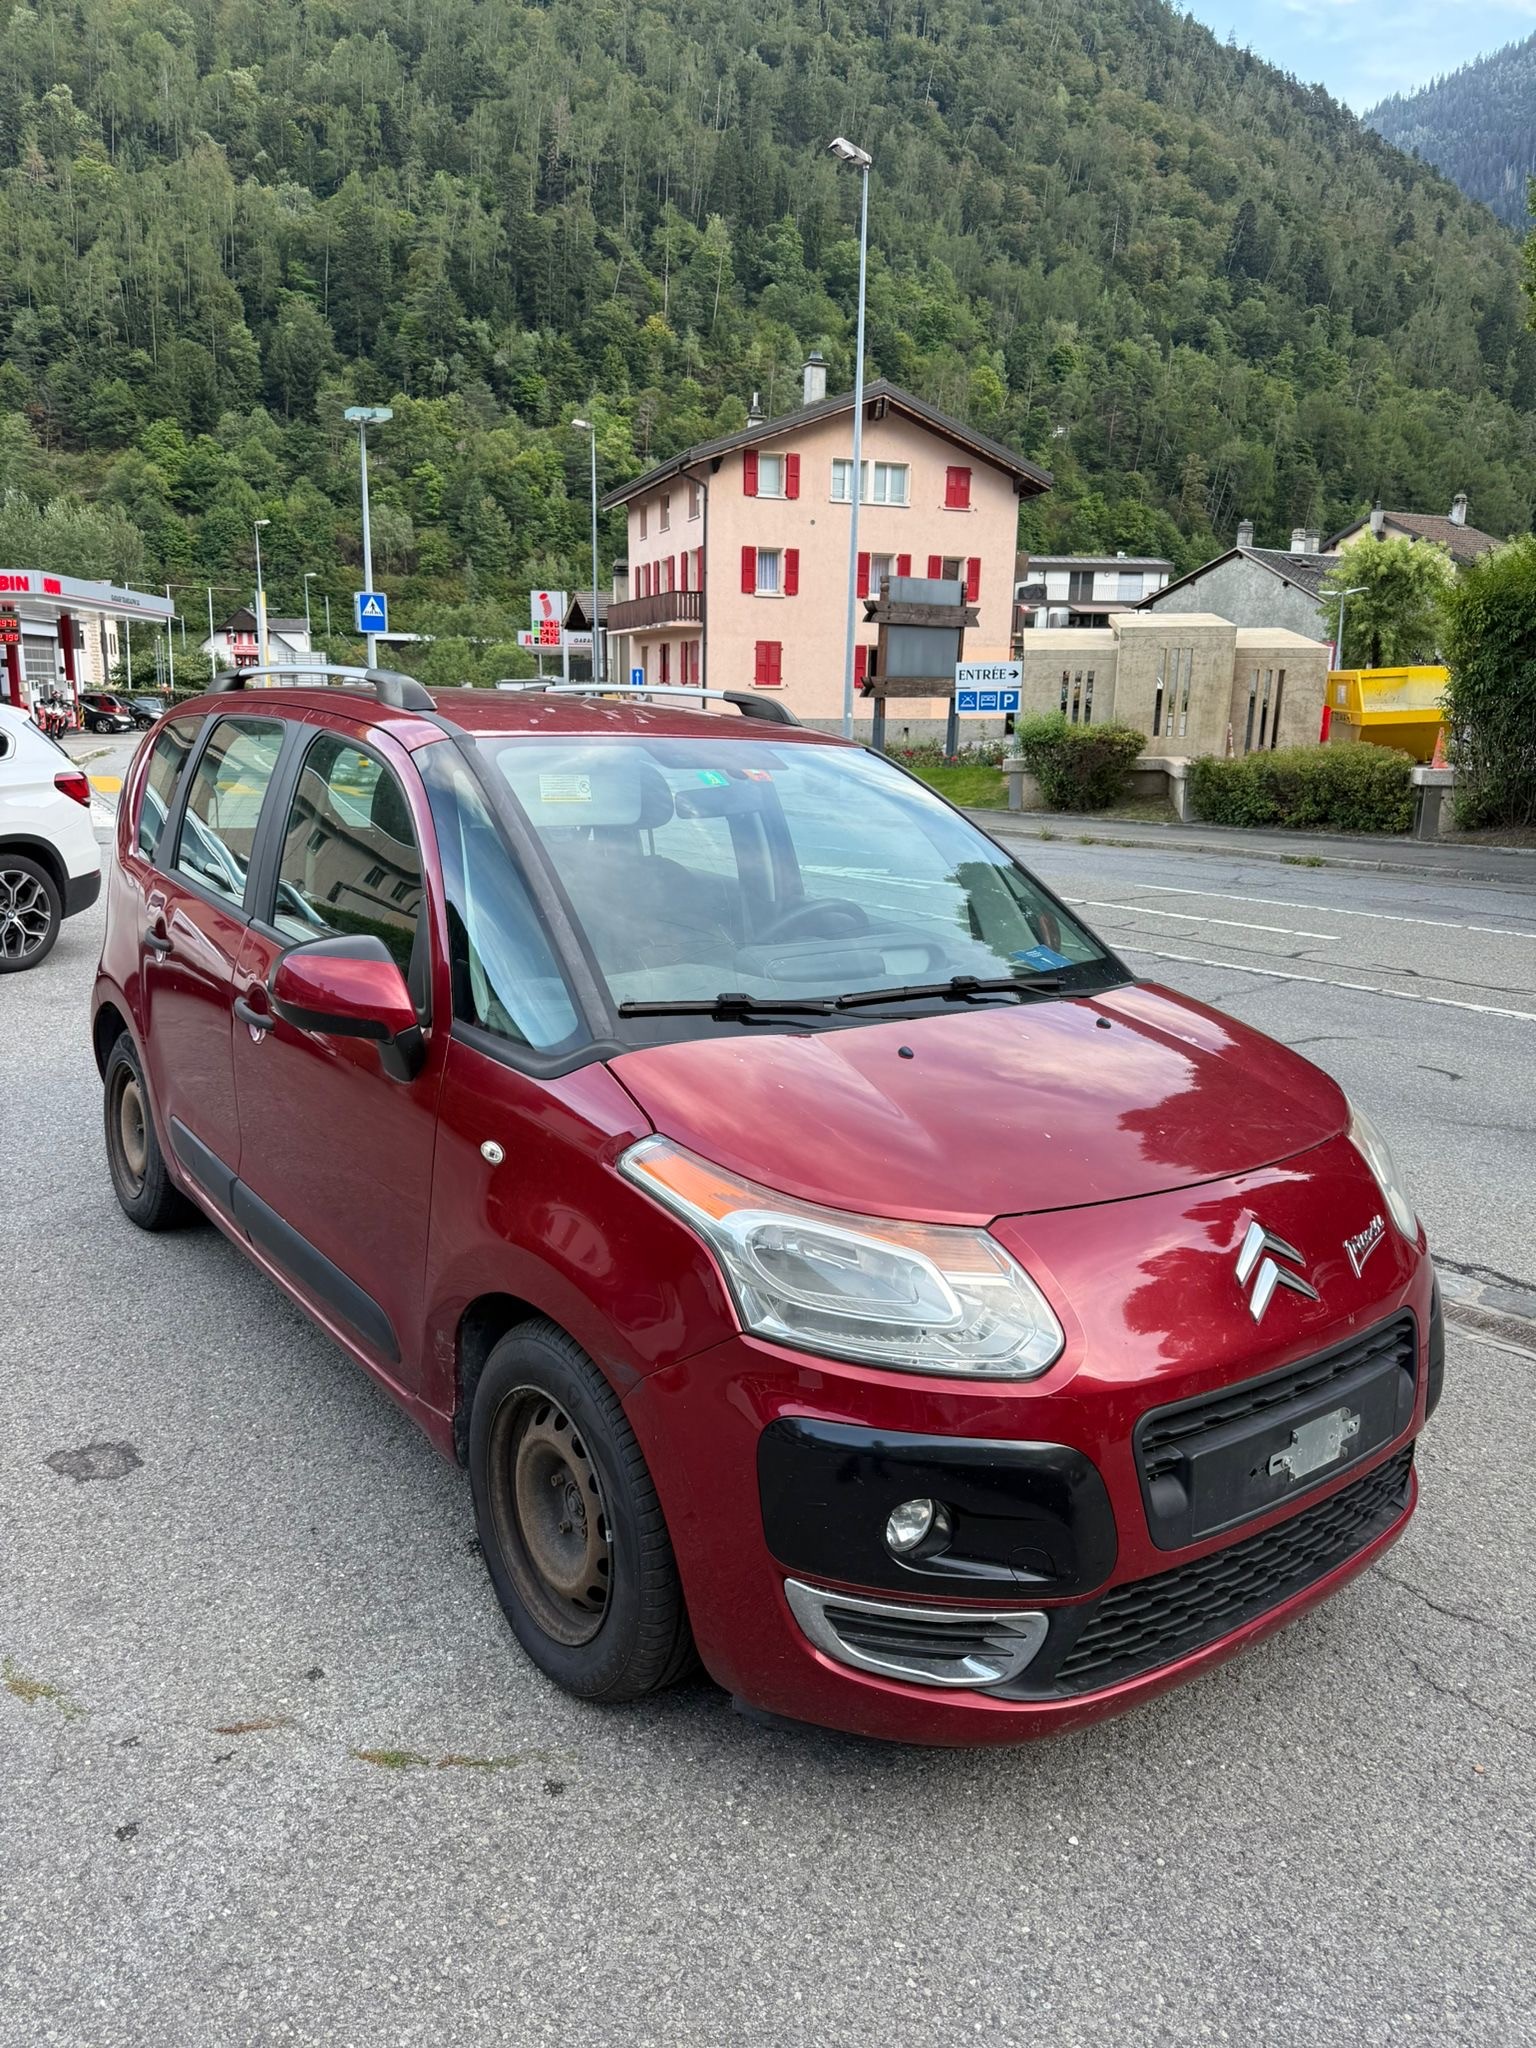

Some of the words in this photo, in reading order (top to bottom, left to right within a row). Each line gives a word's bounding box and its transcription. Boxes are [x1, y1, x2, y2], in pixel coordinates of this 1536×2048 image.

[0, 575, 29, 591] BIN
[959, 666, 1007, 680] ENTRÉE
[1004, 694, 1014, 707] P
